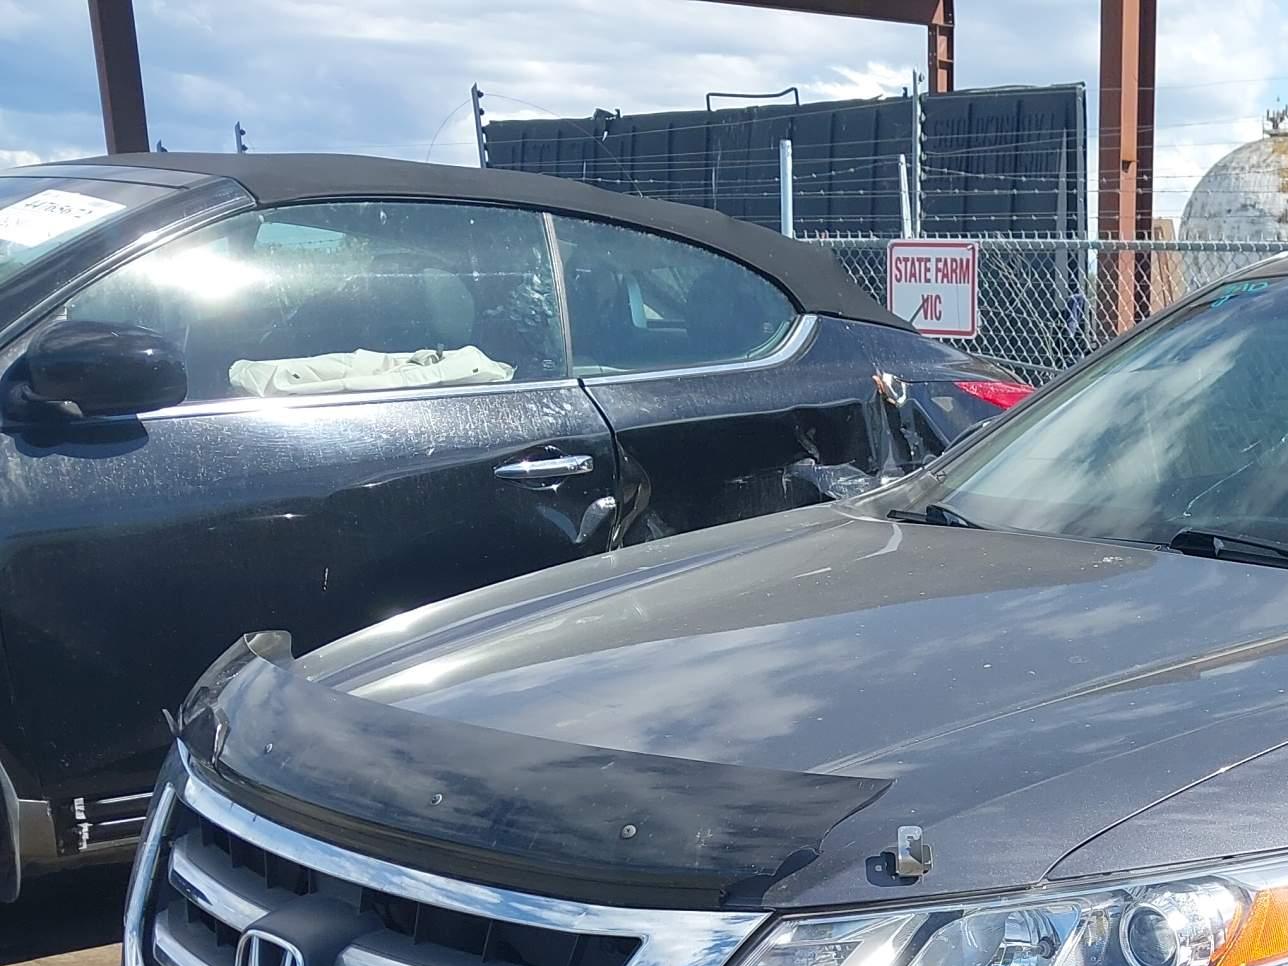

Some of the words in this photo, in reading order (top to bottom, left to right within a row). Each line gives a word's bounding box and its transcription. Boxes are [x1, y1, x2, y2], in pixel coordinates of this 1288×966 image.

[894, 256, 931, 284] STATE
[935, 257, 970, 285] FARM
[921, 294, 943, 321] VIC
